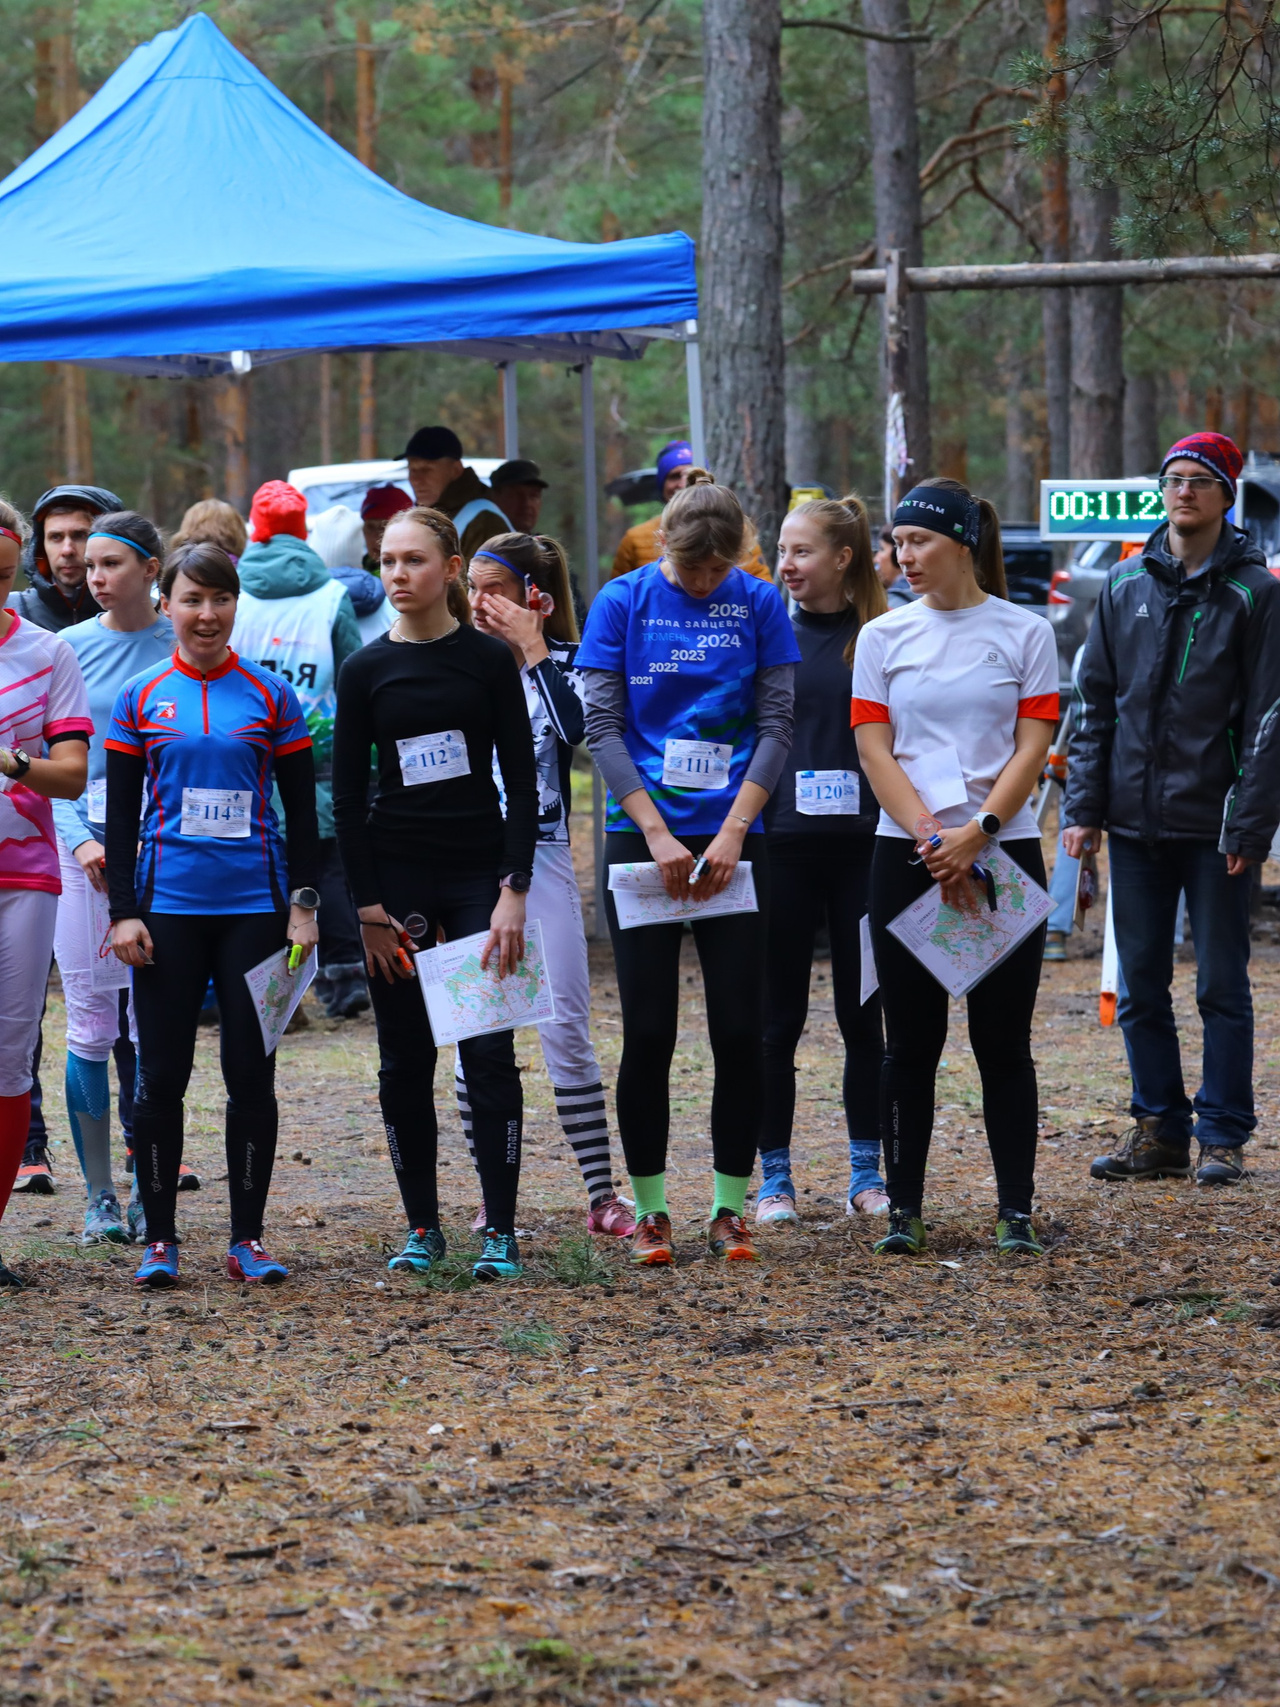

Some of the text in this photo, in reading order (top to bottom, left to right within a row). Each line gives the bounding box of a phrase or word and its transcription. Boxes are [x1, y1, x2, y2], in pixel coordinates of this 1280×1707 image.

[1050, 491, 1167, 520] 00:11.2
[708, 603, 749, 619] 2025
[641, 618, 741, 629] ТРОПА ЗАЙЦЕВА
[641, 632, 690, 643] ТЮМЕНЬ
[696, 633, 742, 648] 2024
[670, 649, 706, 661] 2023
[648, 662, 679, 673] 2022
[630, 676, 653, 685] 2021
[420, 749, 448, 767] 112
[687, 757, 709, 773] 111
[816, 785, 842, 799] 120
[204, 805, 231, 820] 114
[151, 1143, 160, 1179] NORD
